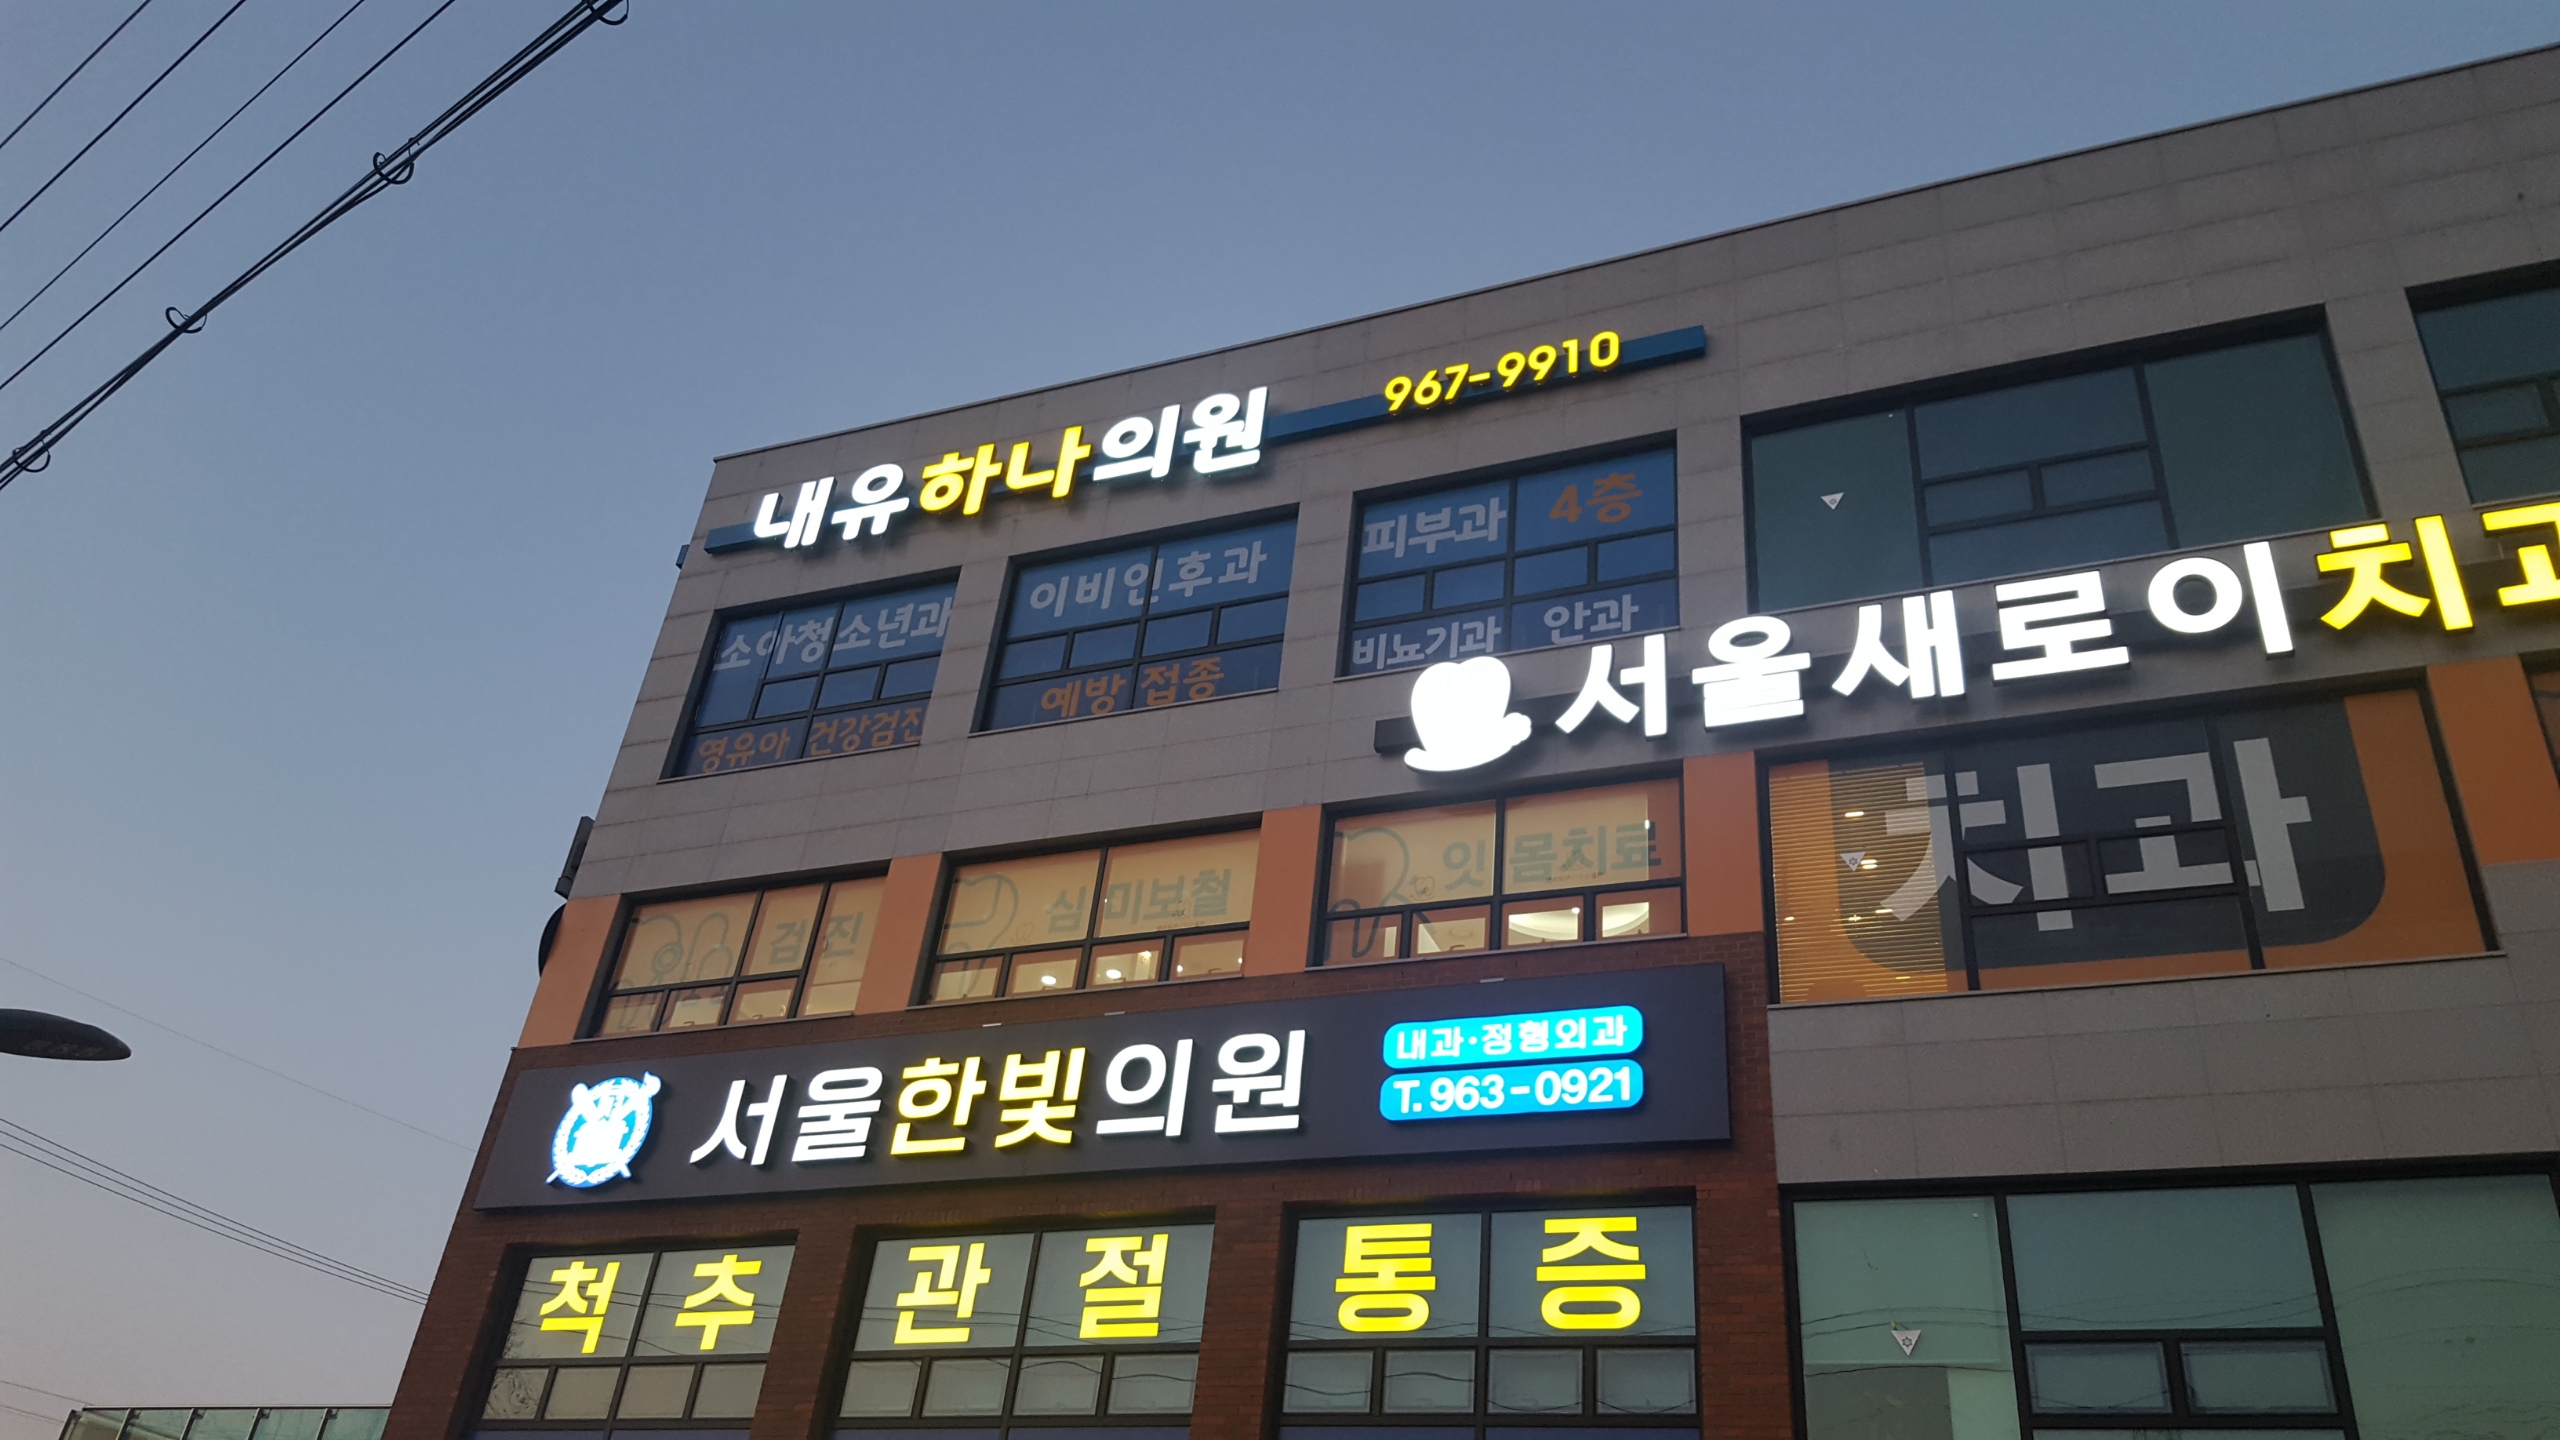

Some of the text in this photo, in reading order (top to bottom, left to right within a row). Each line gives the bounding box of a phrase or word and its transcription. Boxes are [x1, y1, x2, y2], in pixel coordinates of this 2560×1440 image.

[1384, 331, 1620, 412] 967-9910
[1363, 497, 1507, 558] 피부과
[1549, 473, 1643, 523] 4층
[1029, 541, 1267, 618] 이비인후과
[713, 597, 953, 670] 소아청소년과
[1354, 615, 1501, 669] 비뇨기과
[1543, 594, 1640, 645] 안과
[700, 728, 790, 773] 영유아
[1880, 737, 2312, 932] 치과
[690, 1029, 1307, 1166] 서울한빛의원
